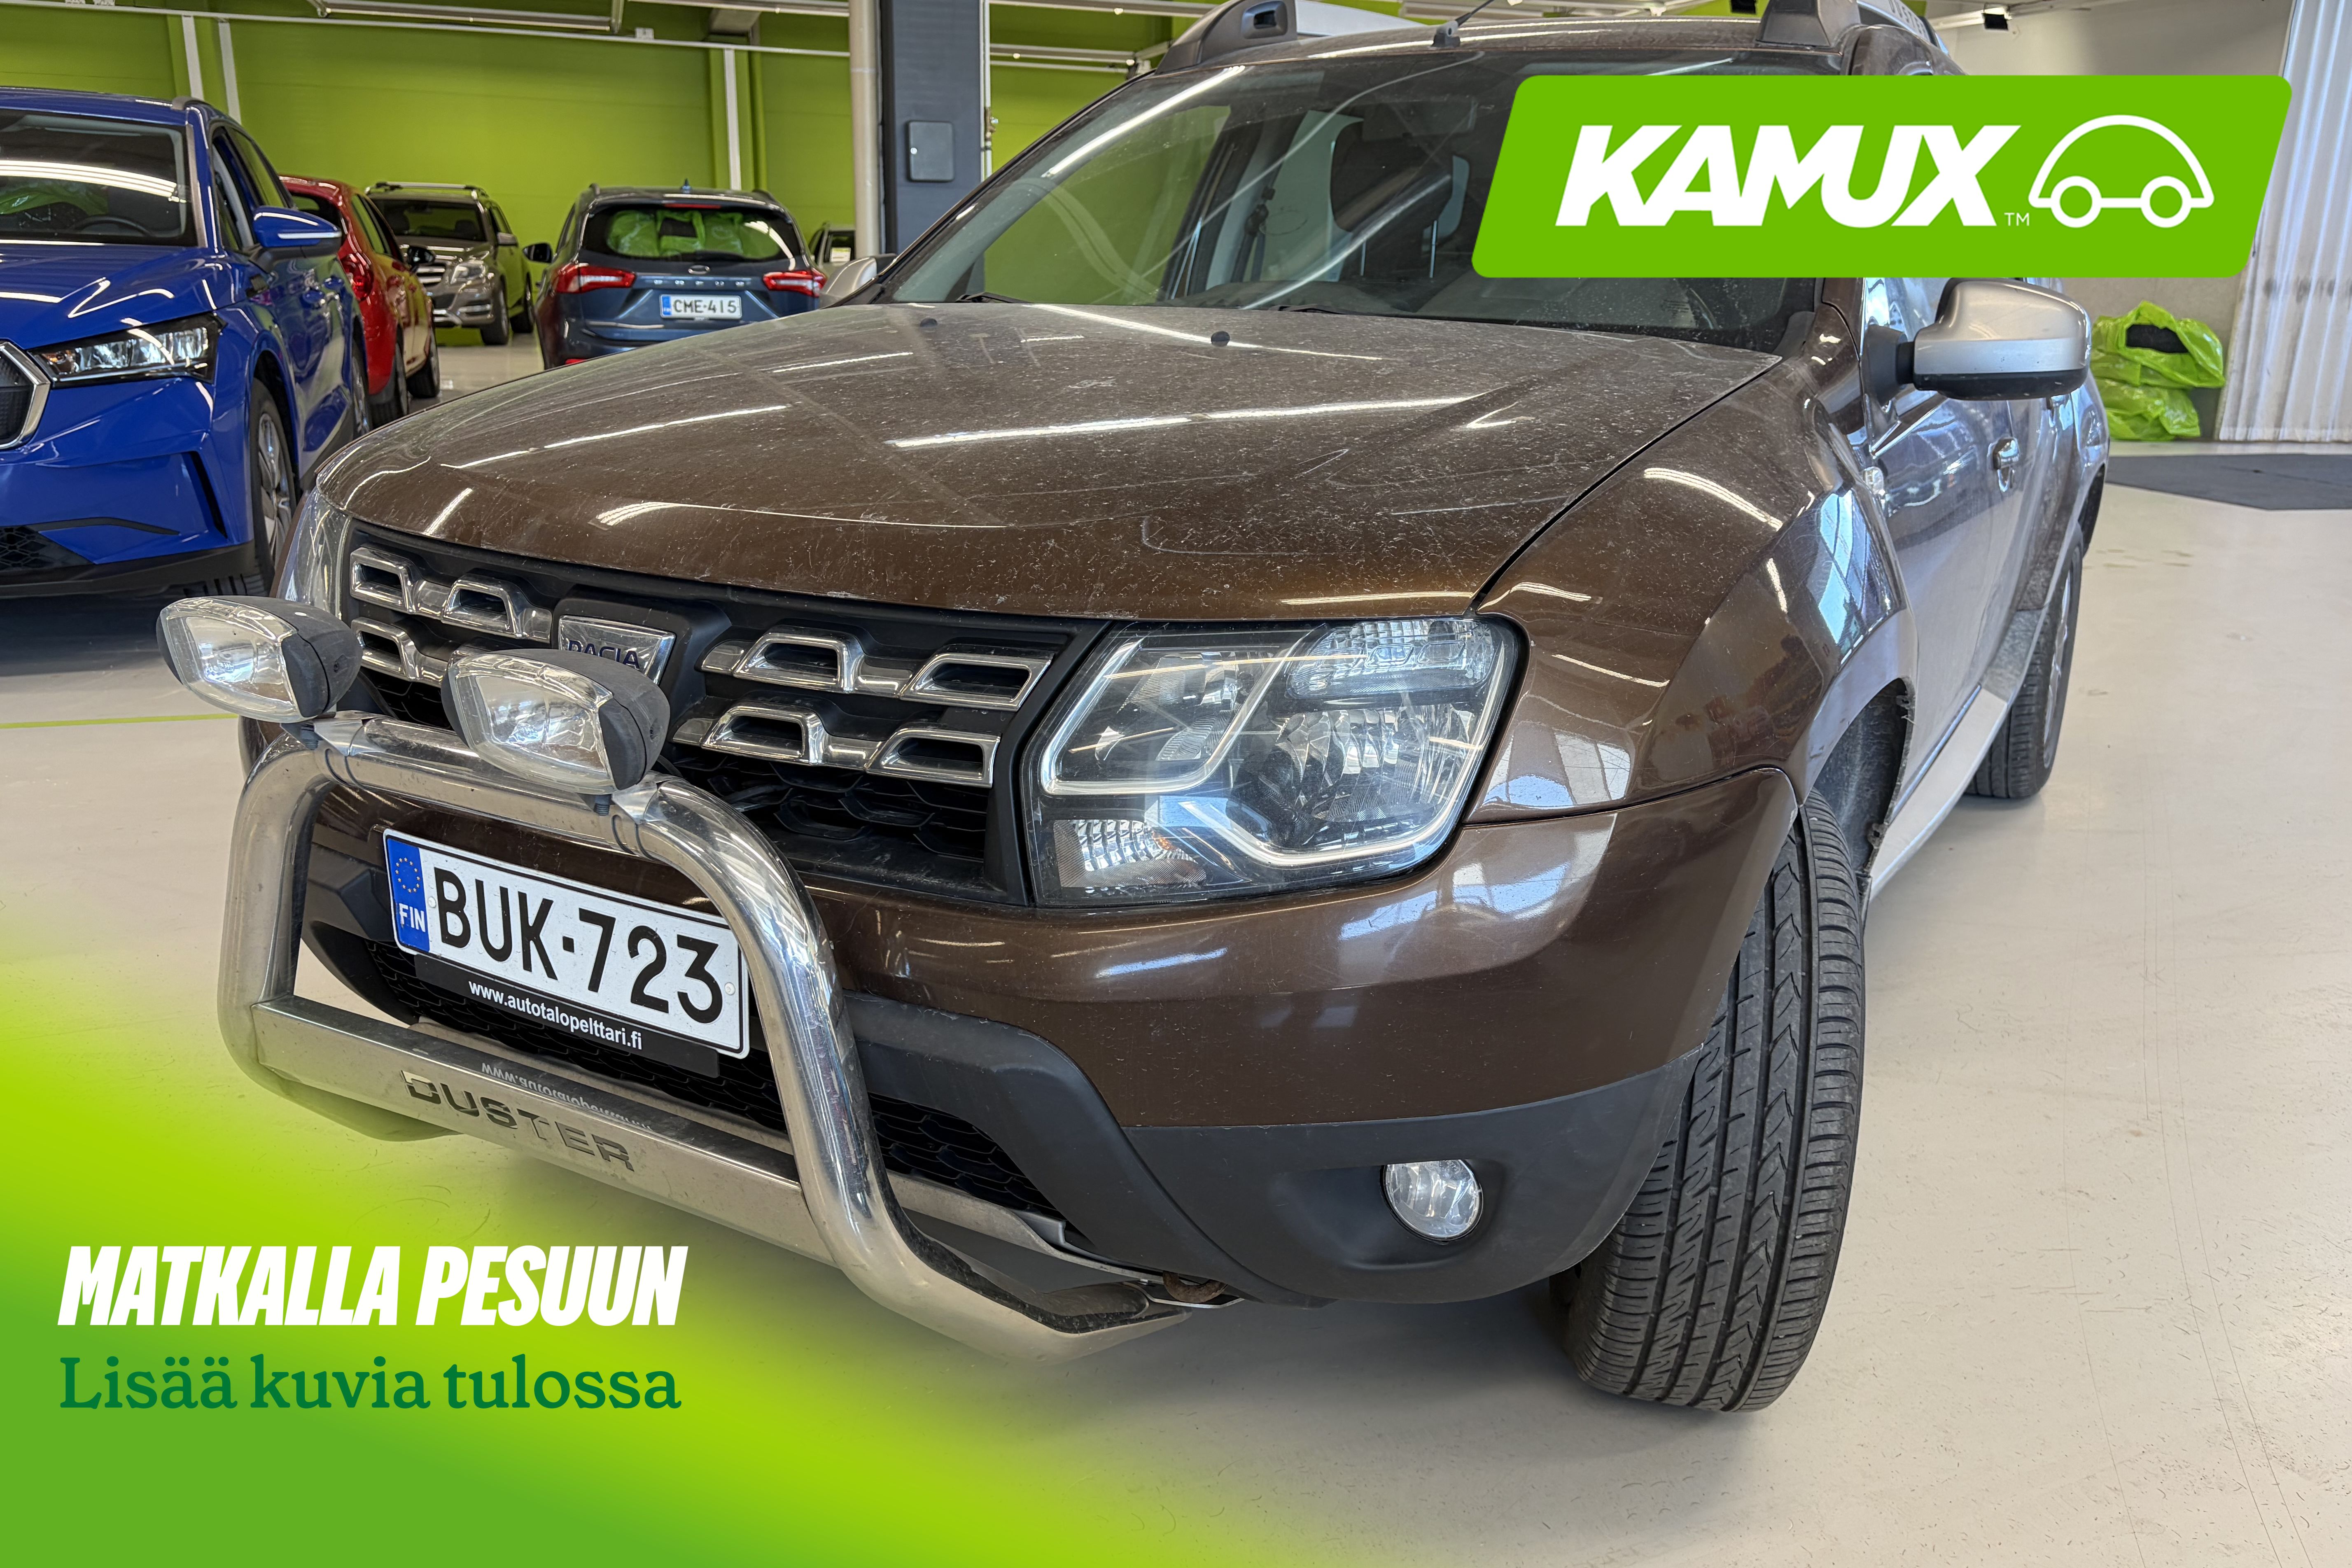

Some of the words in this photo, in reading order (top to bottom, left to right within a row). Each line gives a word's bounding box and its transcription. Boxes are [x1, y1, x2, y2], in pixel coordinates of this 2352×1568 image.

[673, 299, 737, 314] CME-415
[399, 903, 426, 933] FIN
[434, 867, 723, 1024] BUK-723
[468, 981, 642, 1050] www.autotalopelttari.fi
[401, 1070, 635, 1172] DUSTER
